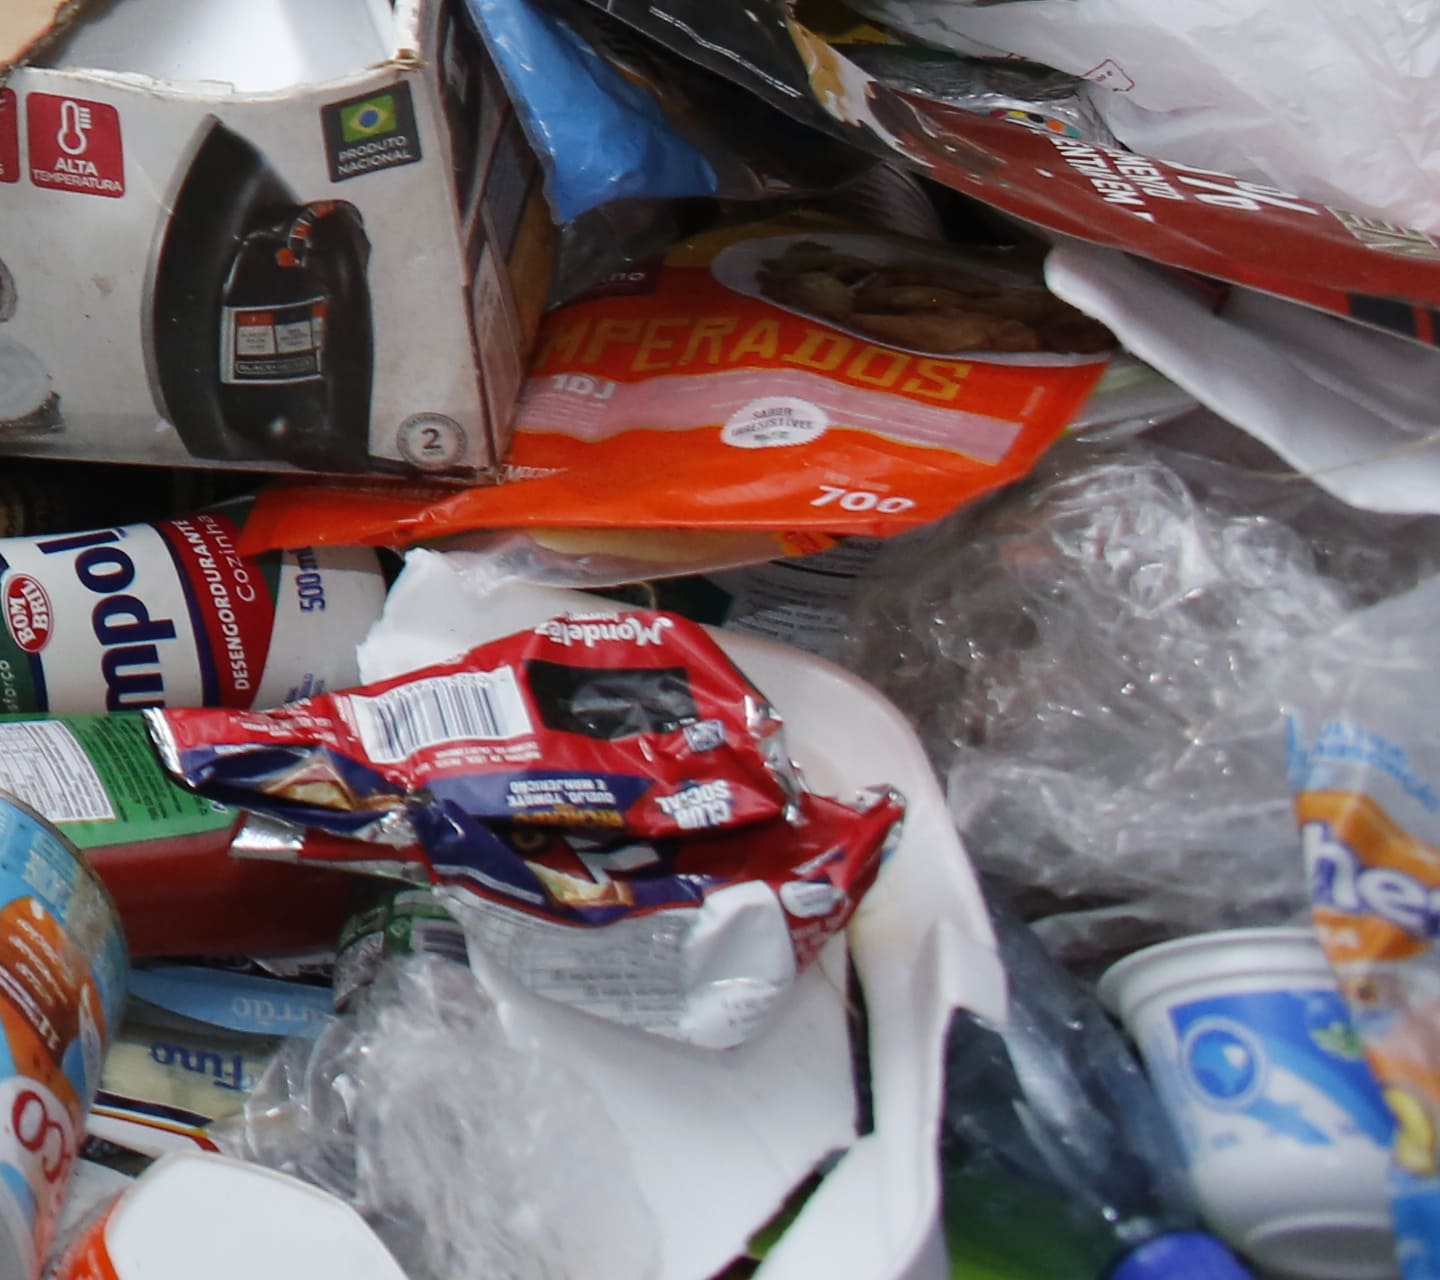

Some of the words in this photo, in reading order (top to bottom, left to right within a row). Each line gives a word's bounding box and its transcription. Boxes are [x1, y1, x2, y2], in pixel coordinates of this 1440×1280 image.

[337, 134, 408, 163] PRODUTO
[337, 149, 414, 176] NACIONAL
[31, 168, 124, 193] TEMPERATURA
[53, 156, 99, 177] ALTA
[421, 426, 444, 452] 2
[196, 514, 257, 603] Cozinha
[21, 581, 50, 631] BRIL
[171, 519, 251, 691] DESENGORDURANTE
[6, 596, 38, 646] BOM
[655, 779, 732, 815] SOCIAL
[674, 801, 732, 830] CLUB
